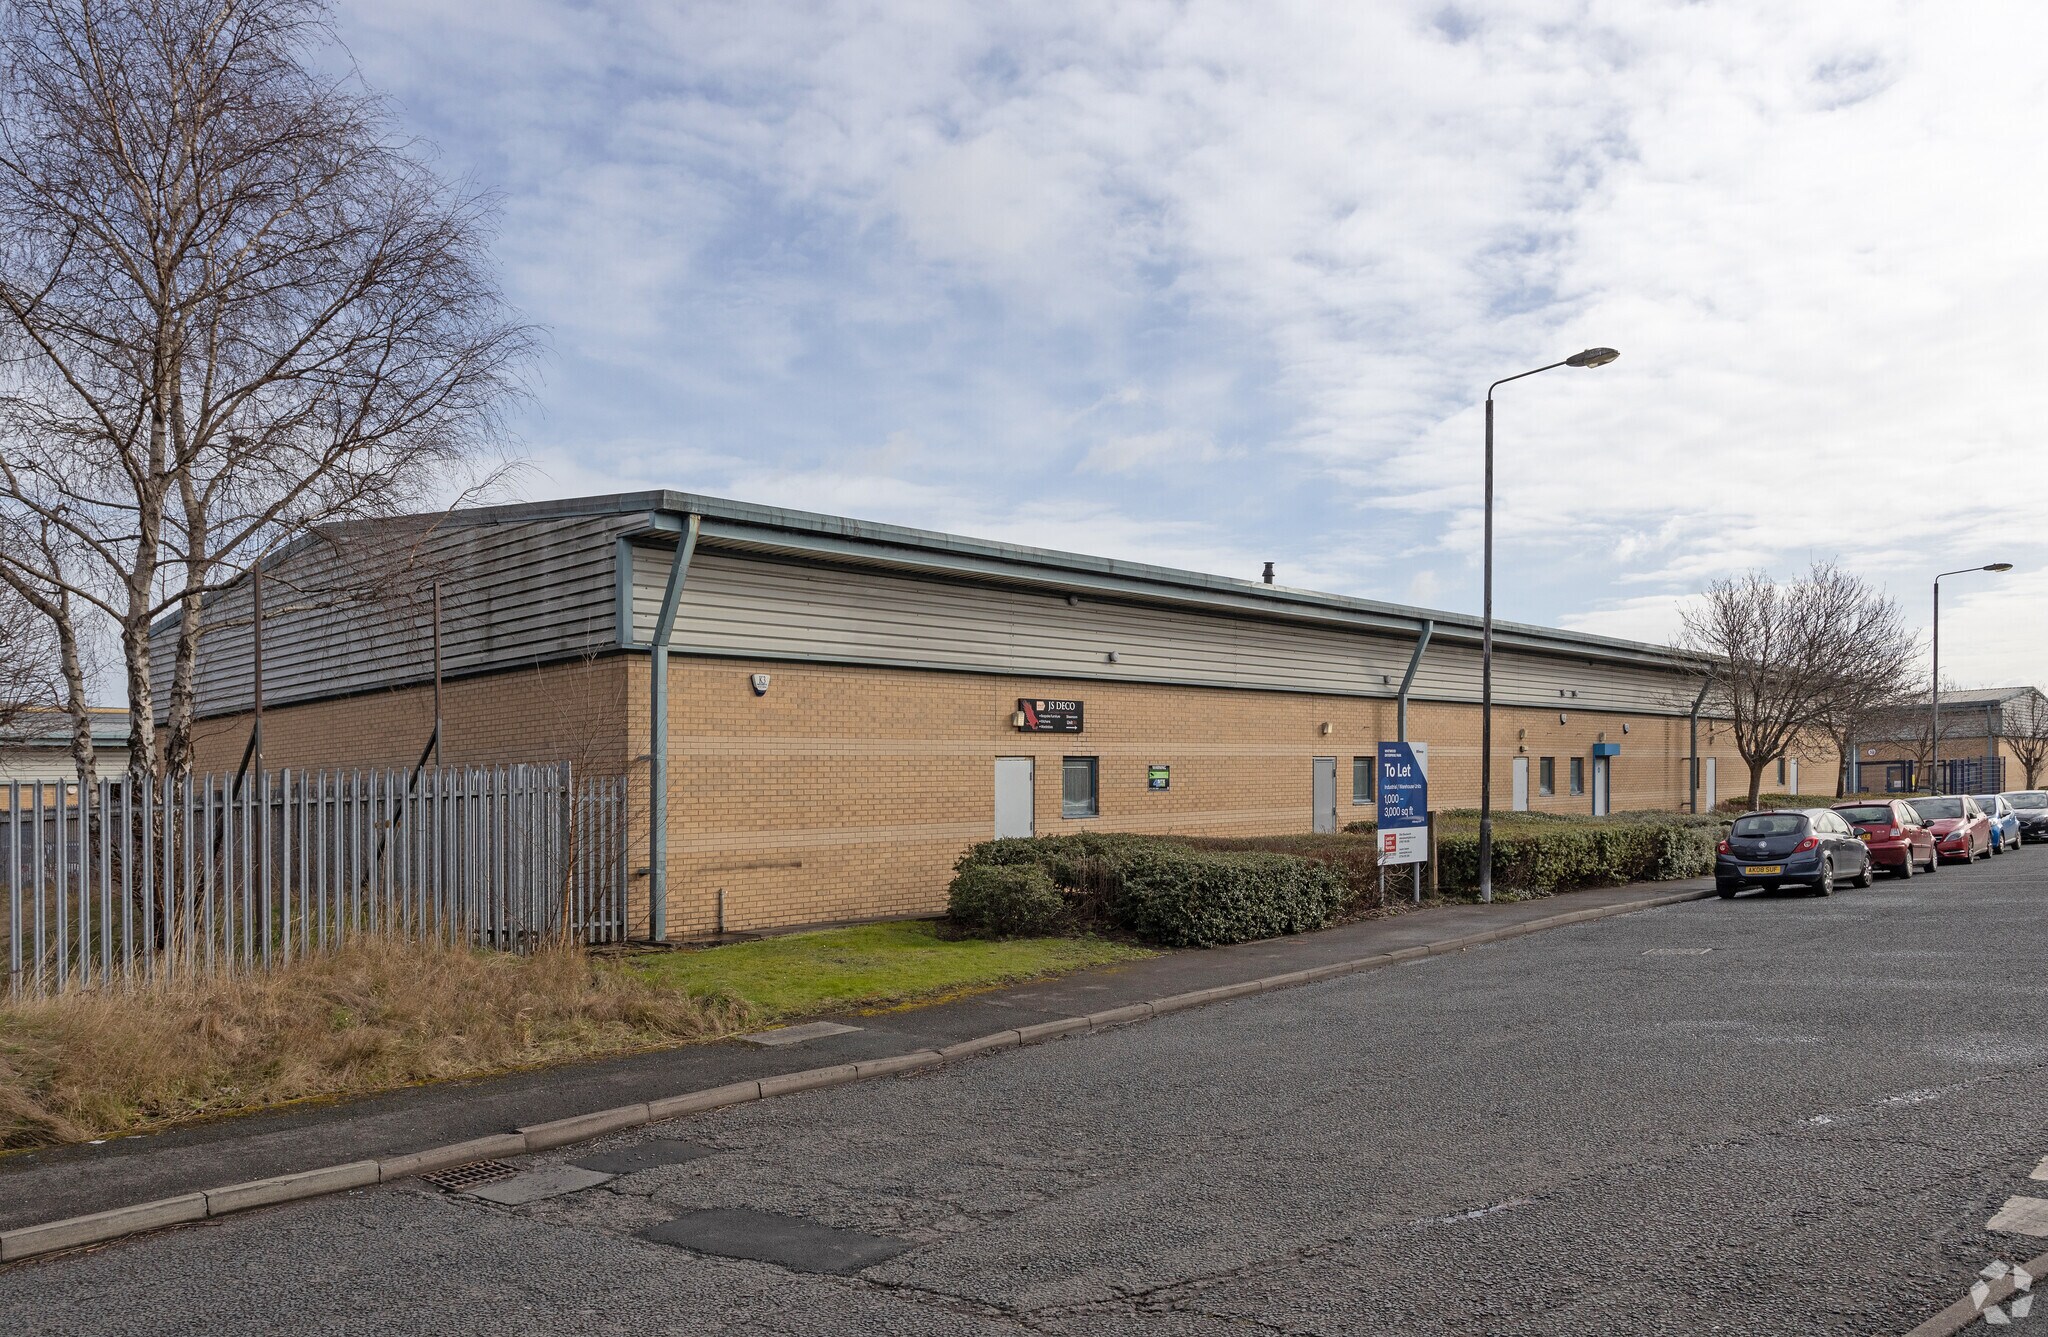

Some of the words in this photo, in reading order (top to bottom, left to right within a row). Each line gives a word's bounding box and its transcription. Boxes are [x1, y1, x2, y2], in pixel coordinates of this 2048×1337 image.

[1048, 701, 1055, 711] JS
[1056, 702, 1076, 710] DECO
[1384, 763, 1396, 777] To
[1397, 763, 1411, 777] Let
[1384, 794, 1399, 805] 1,000
[1384, 806, 1400, 818] 3,000
[1401, 808, 1408, 817] sq
